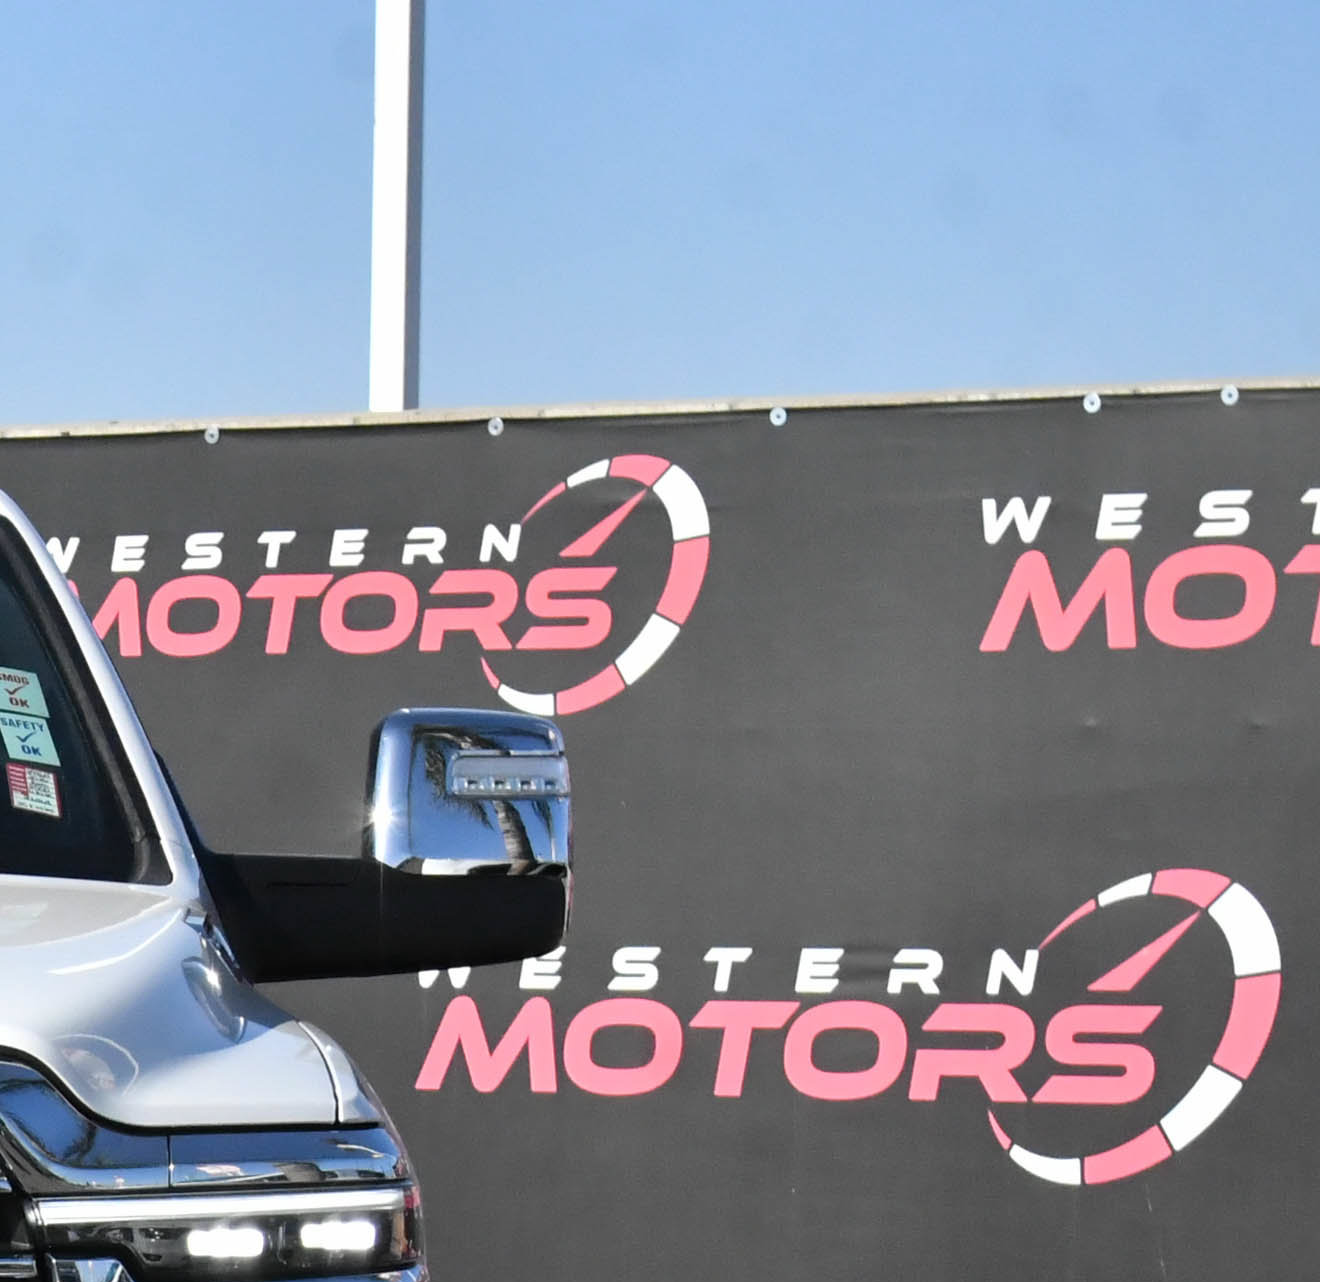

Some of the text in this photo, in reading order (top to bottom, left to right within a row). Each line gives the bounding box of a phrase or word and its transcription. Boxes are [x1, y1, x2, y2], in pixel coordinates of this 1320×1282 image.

[45, 523, 522, 573] WESTERN
[8, 696, 30, 709] OK
[0, 716, 45, 733] SAFETY
[21, 744, 42, 756] OK
[414, 994, 1164, 1106] MOTORS
